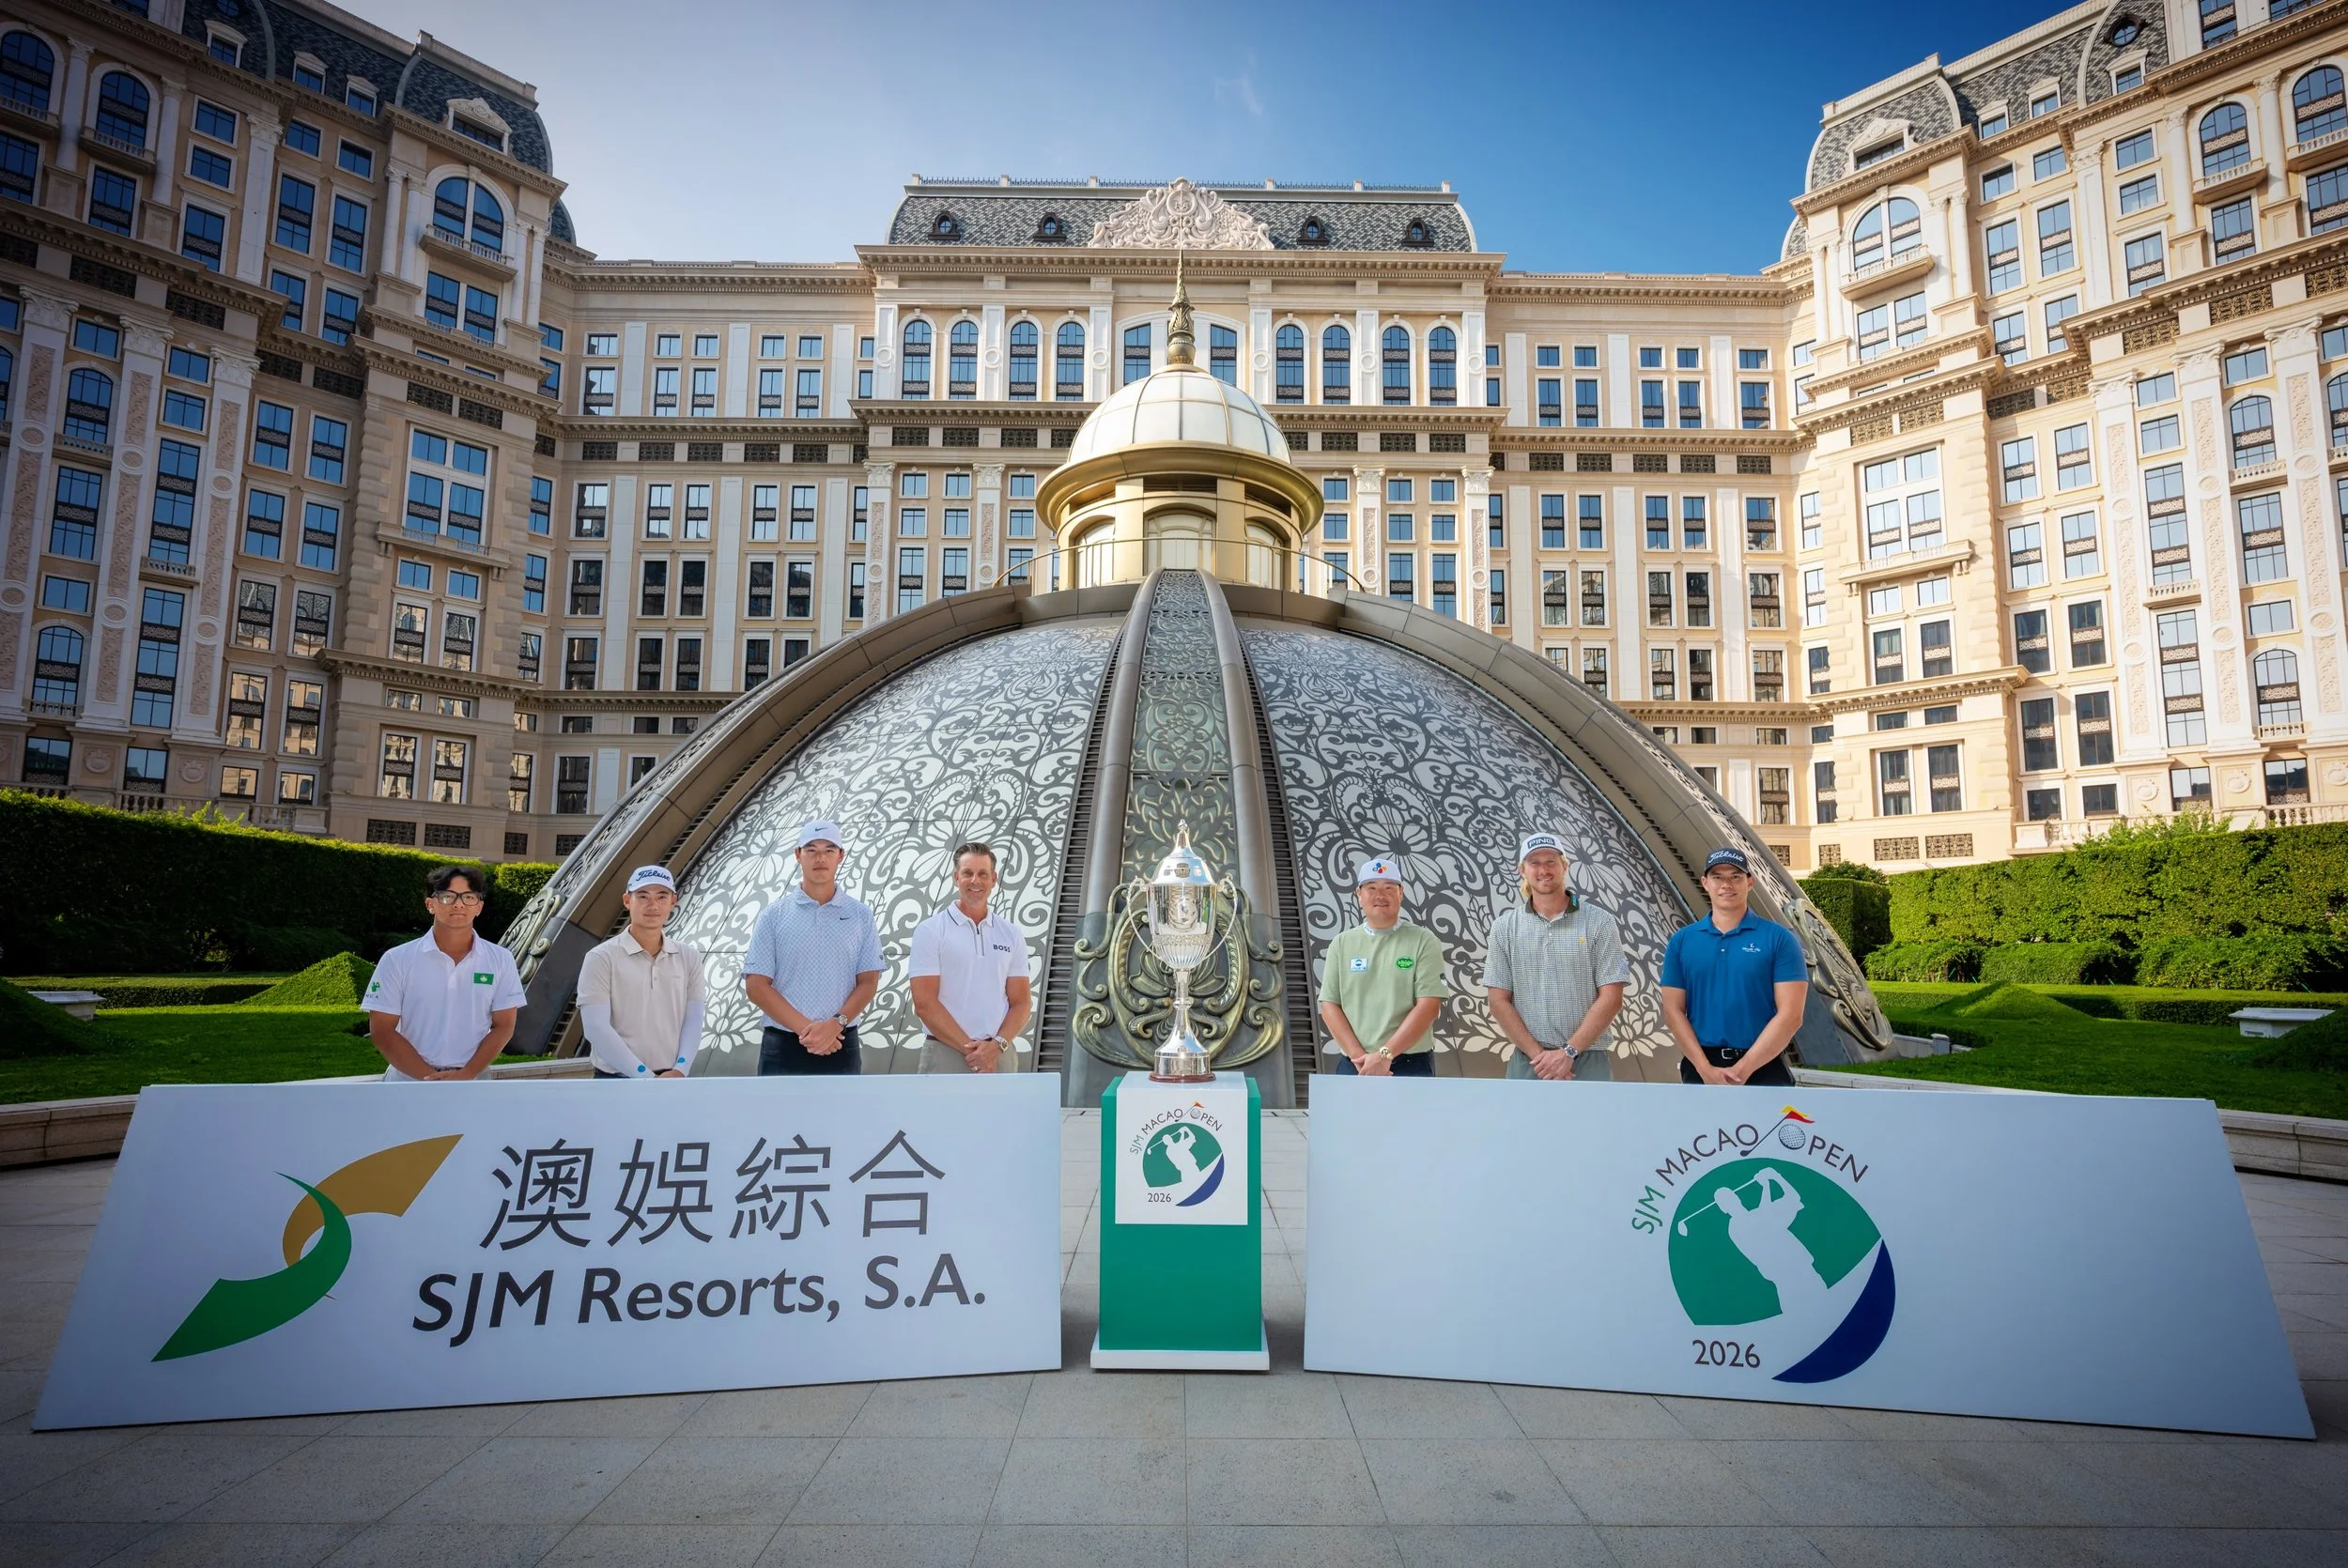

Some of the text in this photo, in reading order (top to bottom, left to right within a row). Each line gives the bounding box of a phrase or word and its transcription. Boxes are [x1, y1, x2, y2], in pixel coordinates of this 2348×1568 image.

[1528, 838, 1554, 847] PING
[993, 944, 1011, 953] BOSS
[1130, 1135, 1144, 1155] SJM
[1141, 1108, 1183, 1135] MACAO
[479, 1130, 947, 1251] 澳娛綜合
[1148, 1192, 1171, 1203] 2026
[1631, 1185, 1666, 1235] SJM
[1655, 1123, 1759, 1186] MACAO
[412, 1253, 986, 1348] SJM Resorts, S.A.
[1691, 1339, 1761, 1369] 2026
